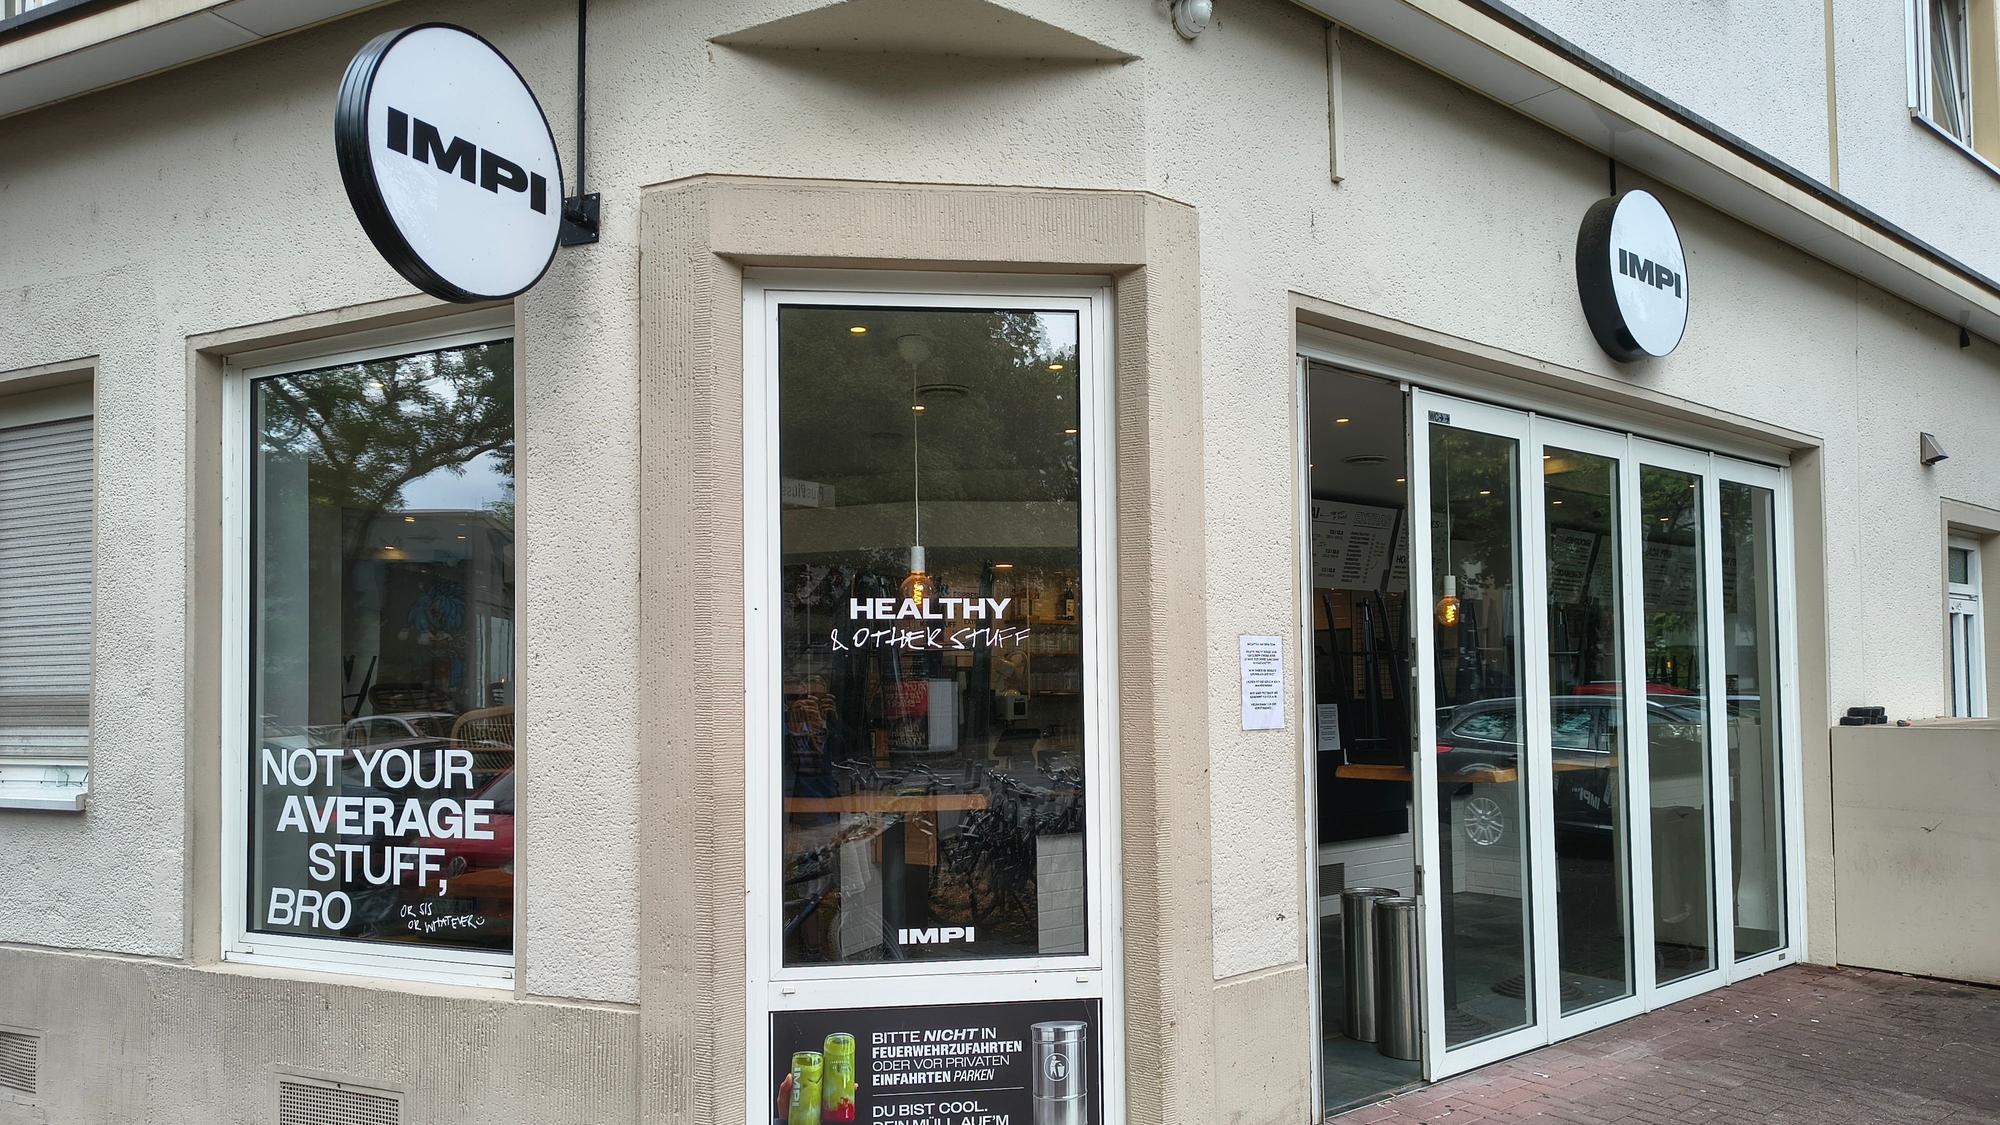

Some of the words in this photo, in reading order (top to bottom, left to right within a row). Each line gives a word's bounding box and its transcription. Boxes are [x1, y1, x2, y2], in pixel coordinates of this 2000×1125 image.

[387, 106, 547, 216] IMPI
[1619, 247, 1682, 299] IMPI
[850, 597, 1012, 620] HEALTHY
[830, 627, 849, 651] &
[852, 625, 944, 650] OTHER
[950, 626, 1031, 650] STUFF
[262, 748, 344, 787] NOT
[352, 748, 474, 790] YOUR
[276, 795, 495, 840] AVERAGE
[308, 842, 447, 897] STUFF,
[267, 887, 352, 930] BRO
[400, 904, 417, 919] OR
[418, 902, 433, 917] SIS
[407, 918, 422, 932] OR
[424, 914, 476, 933] WHATEVER
[898, 926, 975, 945] IMPI
[872, 1030, 921, 1045] BITTE
[923, 1028, 979, 1042] NICHT
[981, 1027, 997, 1039] IN
[872, 1040, 1023, 1059] FEUERWEHRZUFAHRTEN
[872, 1060, 911, 1072] ODER
[913, 1058, 943, 1070] VOR
[946, 1054, 1010, 1068] PRIVATEN
[792, 1067, 801, 1107] IMPI
[872, 1071, 951, 1087] EINFAHRTEN
[953, 1068, 995, 1083] PARKEN
[872, 1105, 896, 1118] DU
[899, 1102, 936, 1117] BIST
[938, 1100, 988, 1114] COOL.
